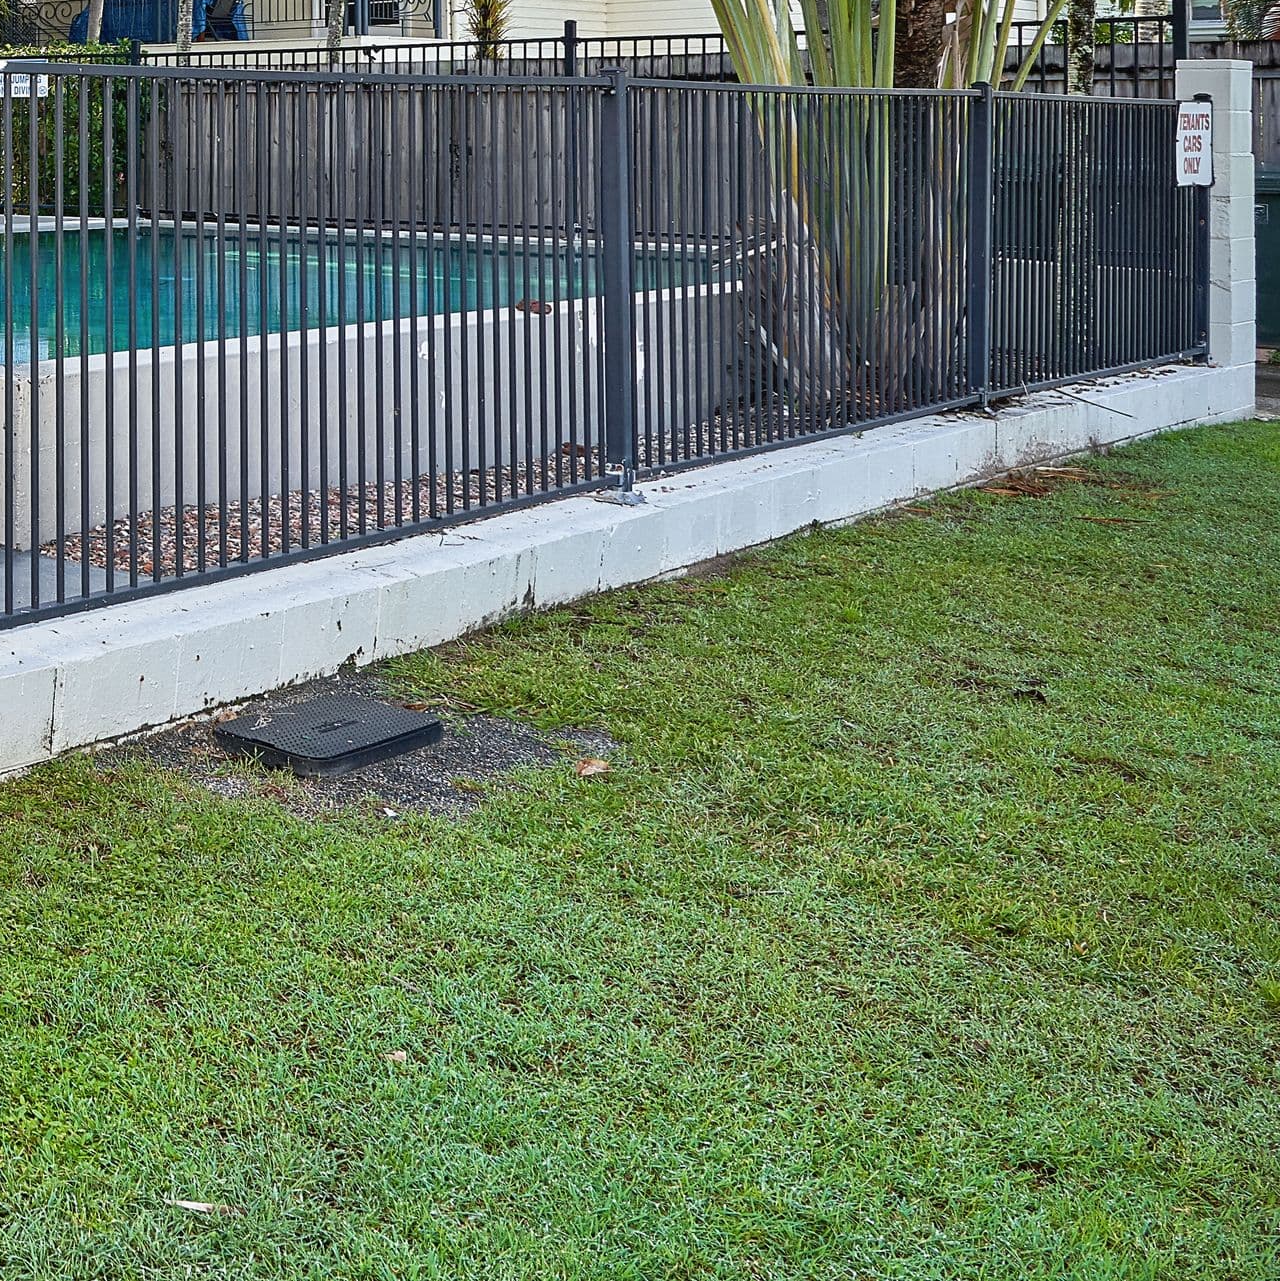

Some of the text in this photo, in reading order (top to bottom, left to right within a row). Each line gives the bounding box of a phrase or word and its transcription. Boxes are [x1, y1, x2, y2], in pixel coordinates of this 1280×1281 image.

[11, 75, 42, 84] JUMPG
[1179, 113, 1210, 130] TENANTS
[1183, 135, 1202, 153] CARS
[1183, 157, 1201, 174] ONLY
